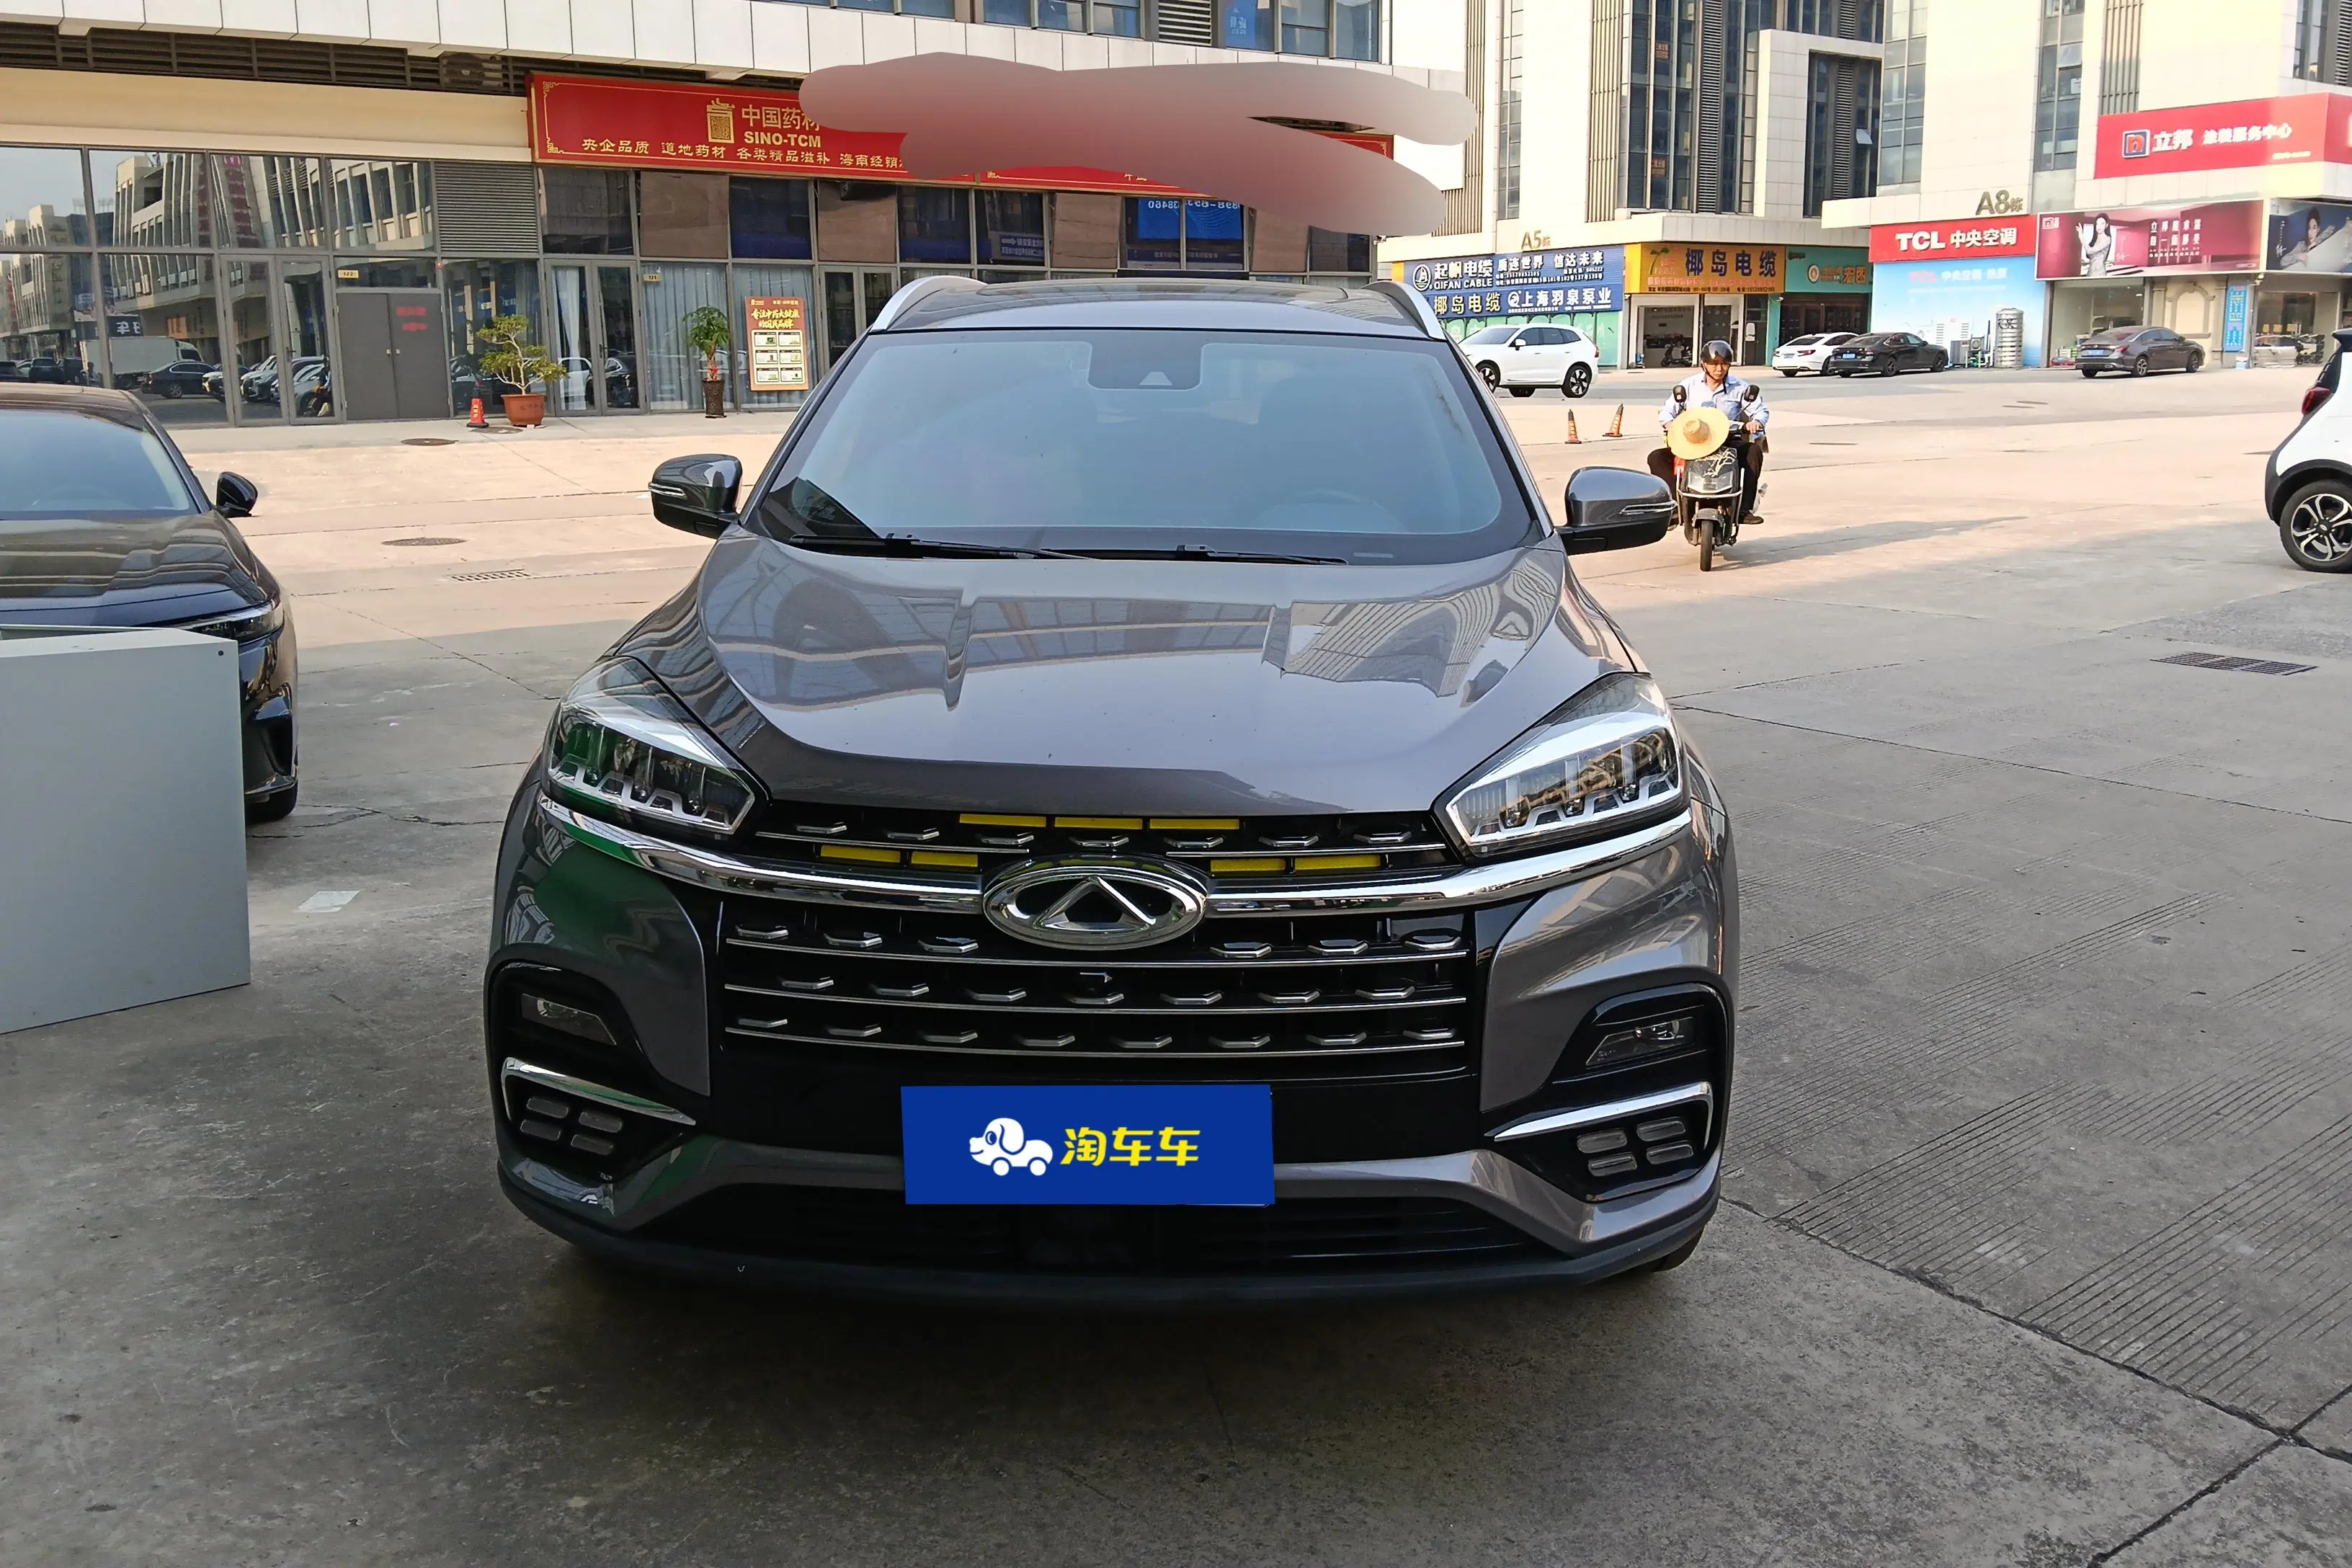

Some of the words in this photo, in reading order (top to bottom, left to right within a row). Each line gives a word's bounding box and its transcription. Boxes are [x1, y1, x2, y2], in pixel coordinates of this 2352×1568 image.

[744, 132, 821, 148] SINO-TCM
[2152, 129, 2193, 151] 立邦
[582, 138, 650, 155] 央企品质
[661, 142, 726, 159] 道地药材
[736, 147, 830, 165] 各类精品滋补
[839, 153, 904, 169] 海南经销
[1895, 231, 1946, 251] TCL
[1950, 227, 2017, 249] 中央空调
[1685, 248, 1777, 277] 椰岛电缆
[1433, 280, 1462, 290] QIFAN
[1464, 277, 1493, 288] CABLE
